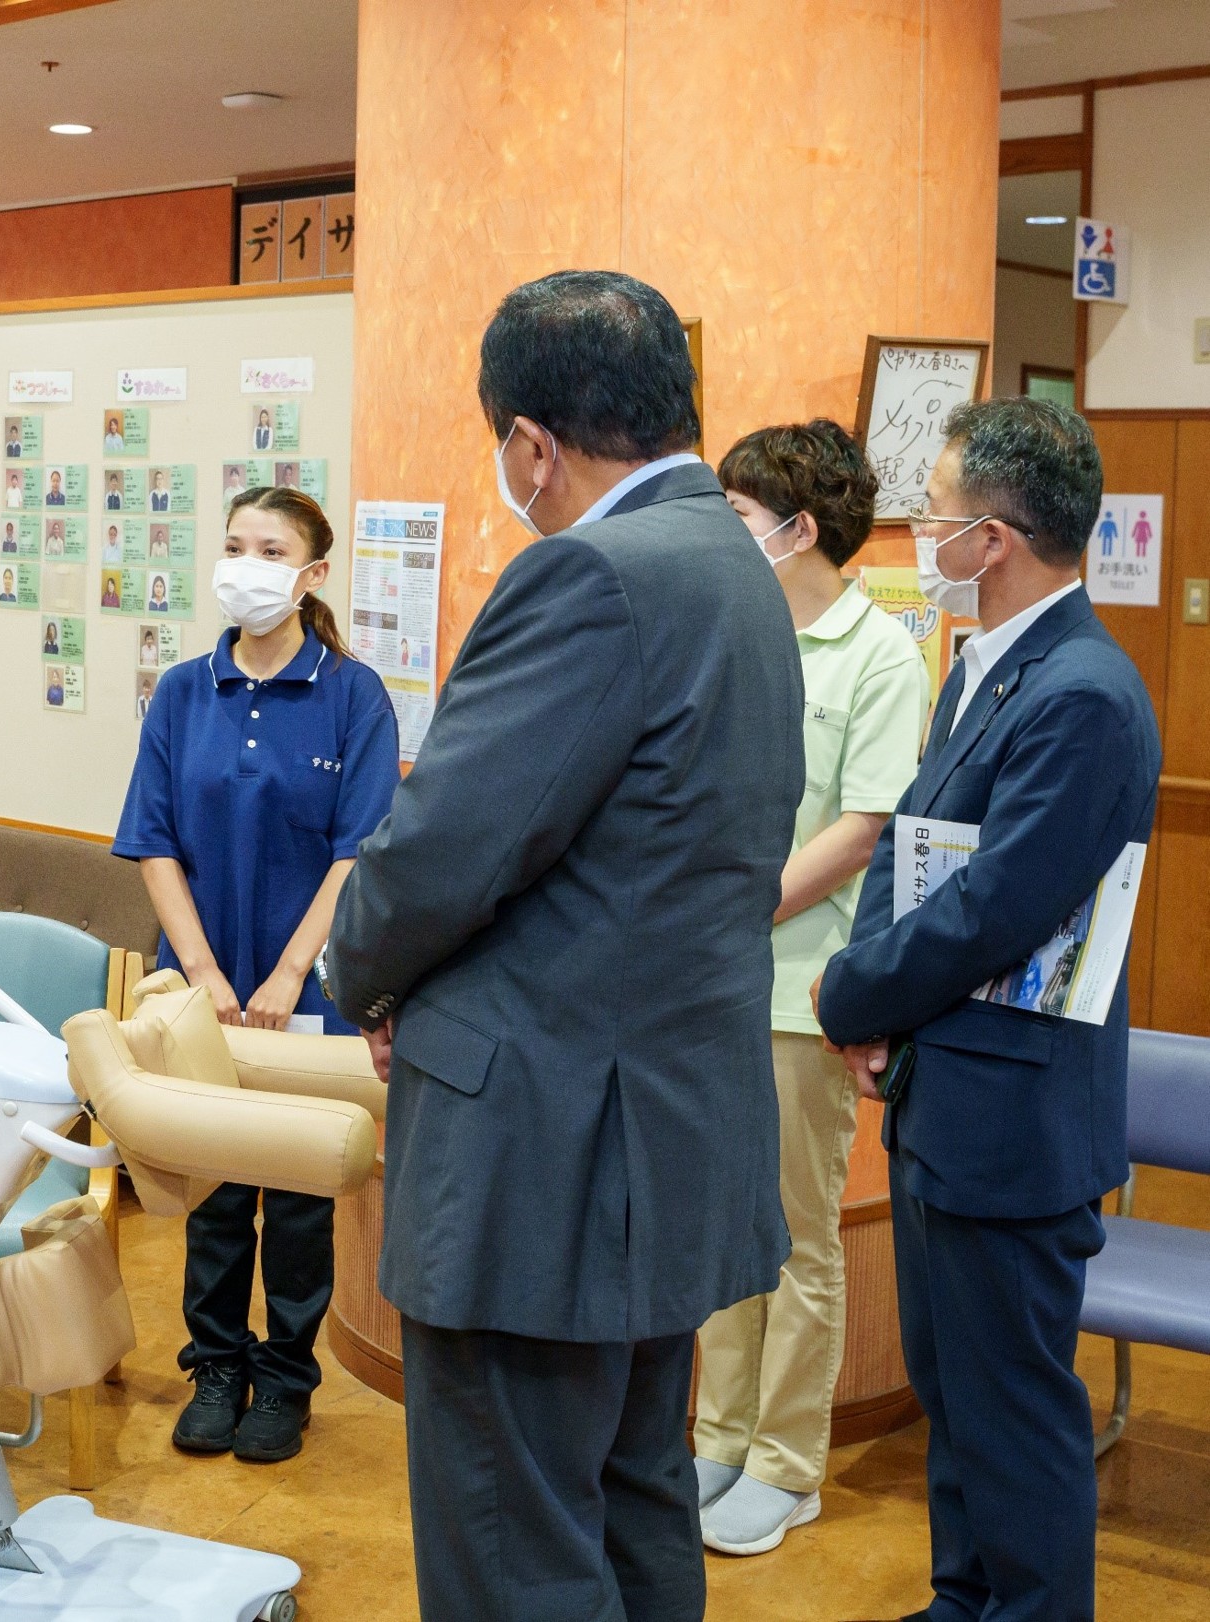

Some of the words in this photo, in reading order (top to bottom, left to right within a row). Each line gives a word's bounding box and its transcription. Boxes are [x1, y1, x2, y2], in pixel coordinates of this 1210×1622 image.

[246, 214, 355, 263] デイサ
[406, 522, 436, 538] NEWS
[1098, 562, 1148, 576] お手洗い
